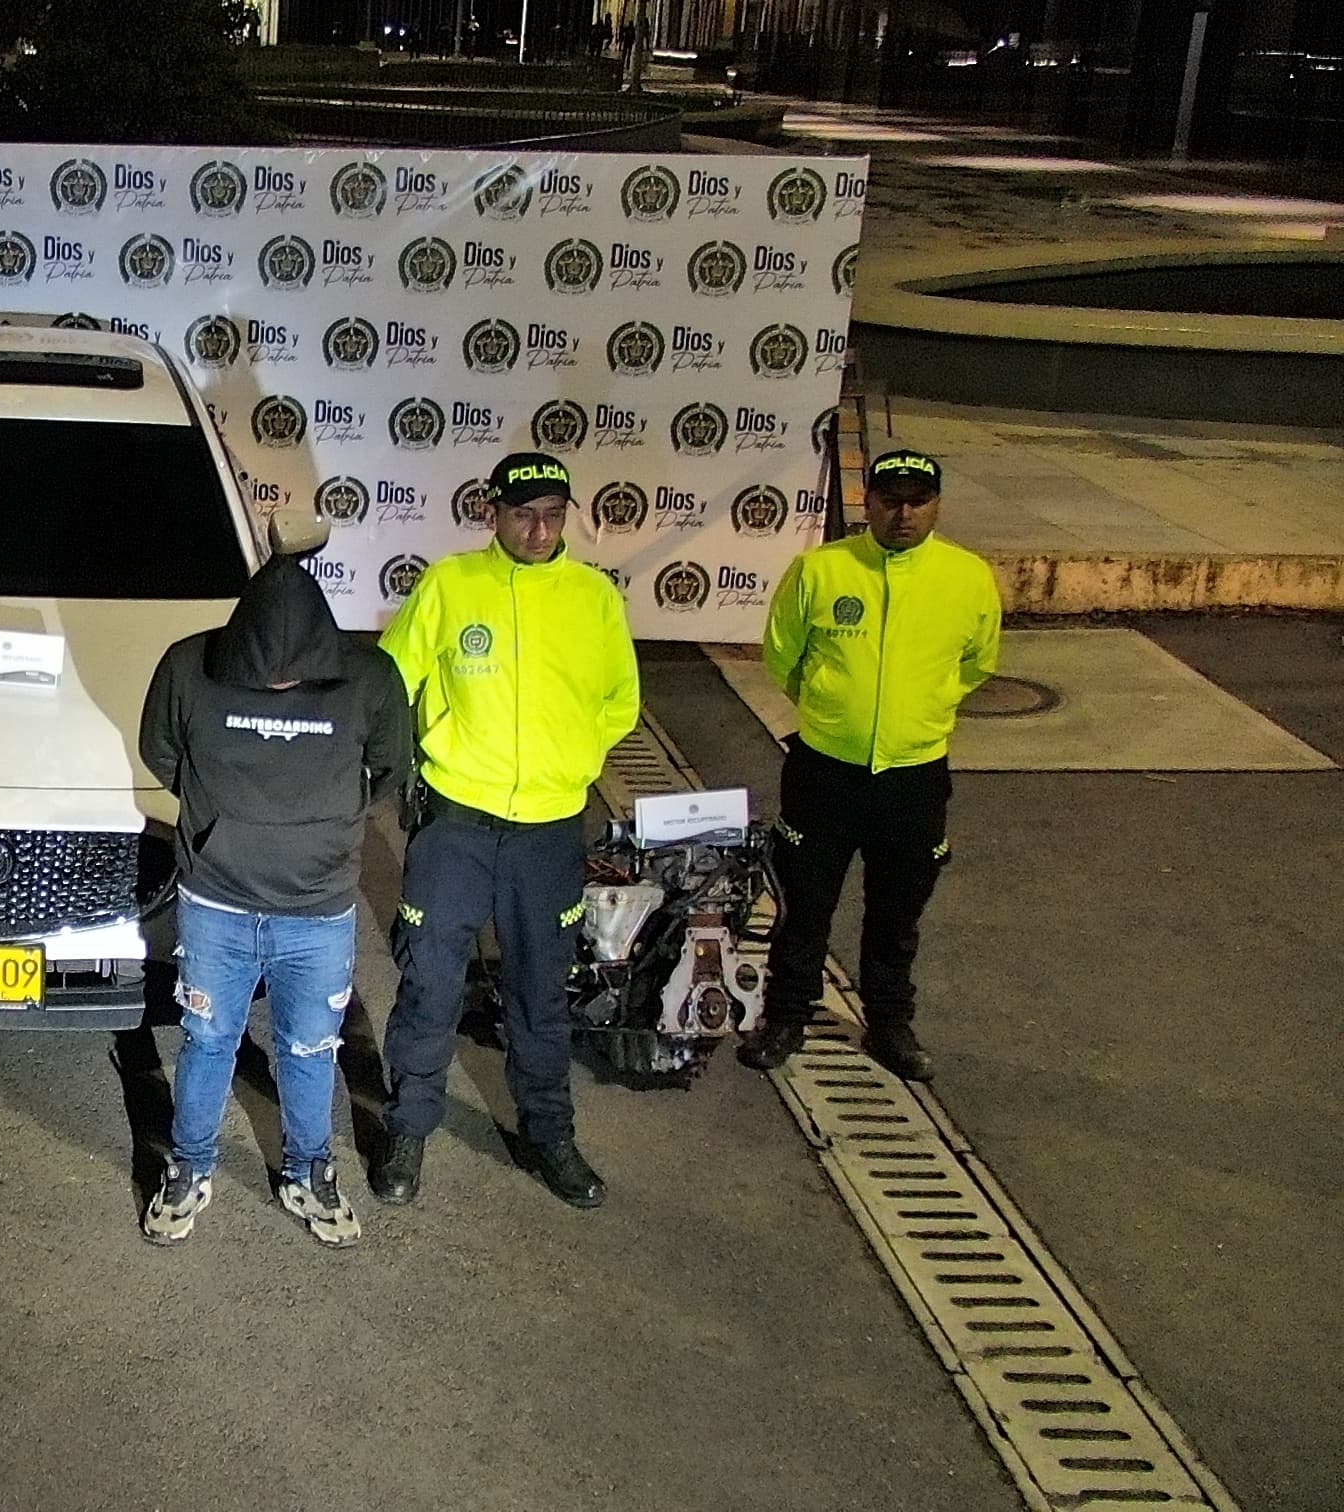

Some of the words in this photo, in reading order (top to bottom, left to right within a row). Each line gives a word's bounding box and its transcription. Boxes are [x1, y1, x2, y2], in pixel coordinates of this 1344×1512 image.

[19, 176, 24, 190] y
[115, 164, 153, 189] Dios
[160, 179, 166, 192] y
[255, 166, 293, 191] Dios
[300, 181, 306, 195] y
[396, 167, 435, 192] Dios
[441, 182, 448, 196] y
[540, 169, 580, 194] Dios
[586, 184, 593, 197] y
[688, 170, 728, 196] Dios
[735, 186, 741, 200] y
[44, 236, 82, 260] Dios
[88, 251, 94, 264] y
[184, 238, 221, 263] Dios
[228, 252, 233, 266] y
[323, 240, 361, 265] Dios
[368, 255, 374, 268] y
[464, 242, 504, 267] Dios
[509, 256, 516, 270] y
[611, 244, 651, 268] Dios
[656, 258, 663, 272] y
[754, 246, 795, 271] Dios
[800, 261, 807, 274] y
[247, 320, 286, 344] Dios
[293, 335, 299, 348] y
[387, 322, 425, 347] Dios
[432, 336, 438, 350] y
[528, 324, 567, 349] Dios
[573, 338, 579, 352] y
[673, 326, 712, 350] Dios
[718, 341, 725, 354] y
[315, 400, 352, 423] Dios
[359, 414, 365, 427] y
[453, 402, 491, 426] Dios
[497, 416, 504, 429] y
[596, 404, 635, 429] Dios
[639, 419, 647, 433] y
[736, 407, 775, 431] Dios
[781, 422, 788, 435] y
[377, 481, 414, 504] Dios
[421, 494, 427, 507] y
[656, 486, 694, 510] Dios
[699, 501, 707, 514] y
[350, 570, 355, 581] y
[718, 566, 756, 589] Dios
[762, 580, 768, 592] y
[226, 715, 333, 735] SKATEBOARDING
